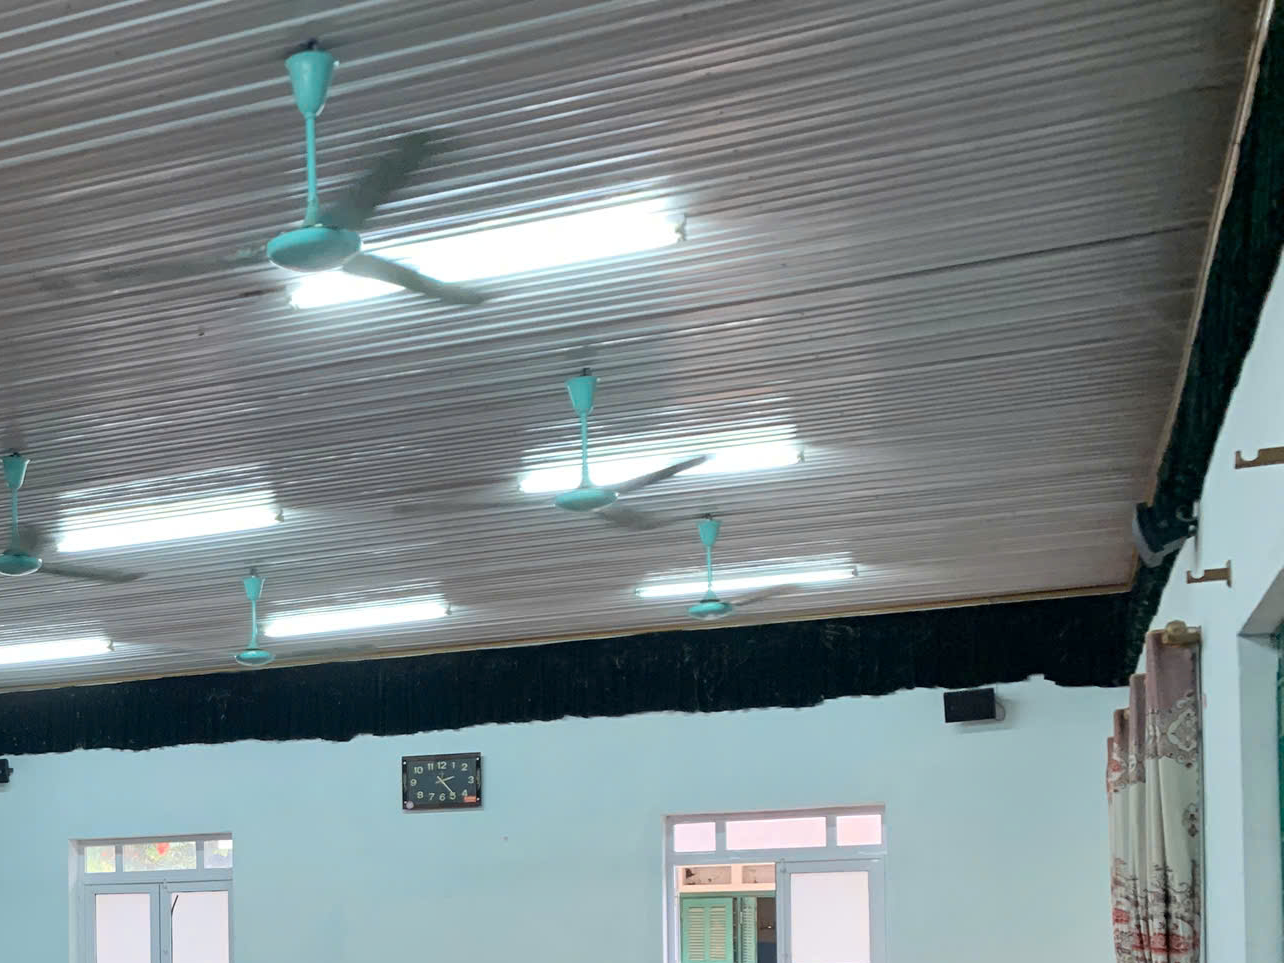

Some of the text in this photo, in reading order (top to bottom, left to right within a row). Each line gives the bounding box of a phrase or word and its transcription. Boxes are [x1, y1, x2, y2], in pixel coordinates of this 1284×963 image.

[428, 763, 434, 771] 11
[437, 761, 447, 769] 12
[461, 763, 468, 771] 2
[411, 778, 417, 786] 9
[468, 776, 474, 784] 3
[417, 791, 424, 799] 8
[439, 793, 446, 801] 6
[450, 792, 456, 800] 5
